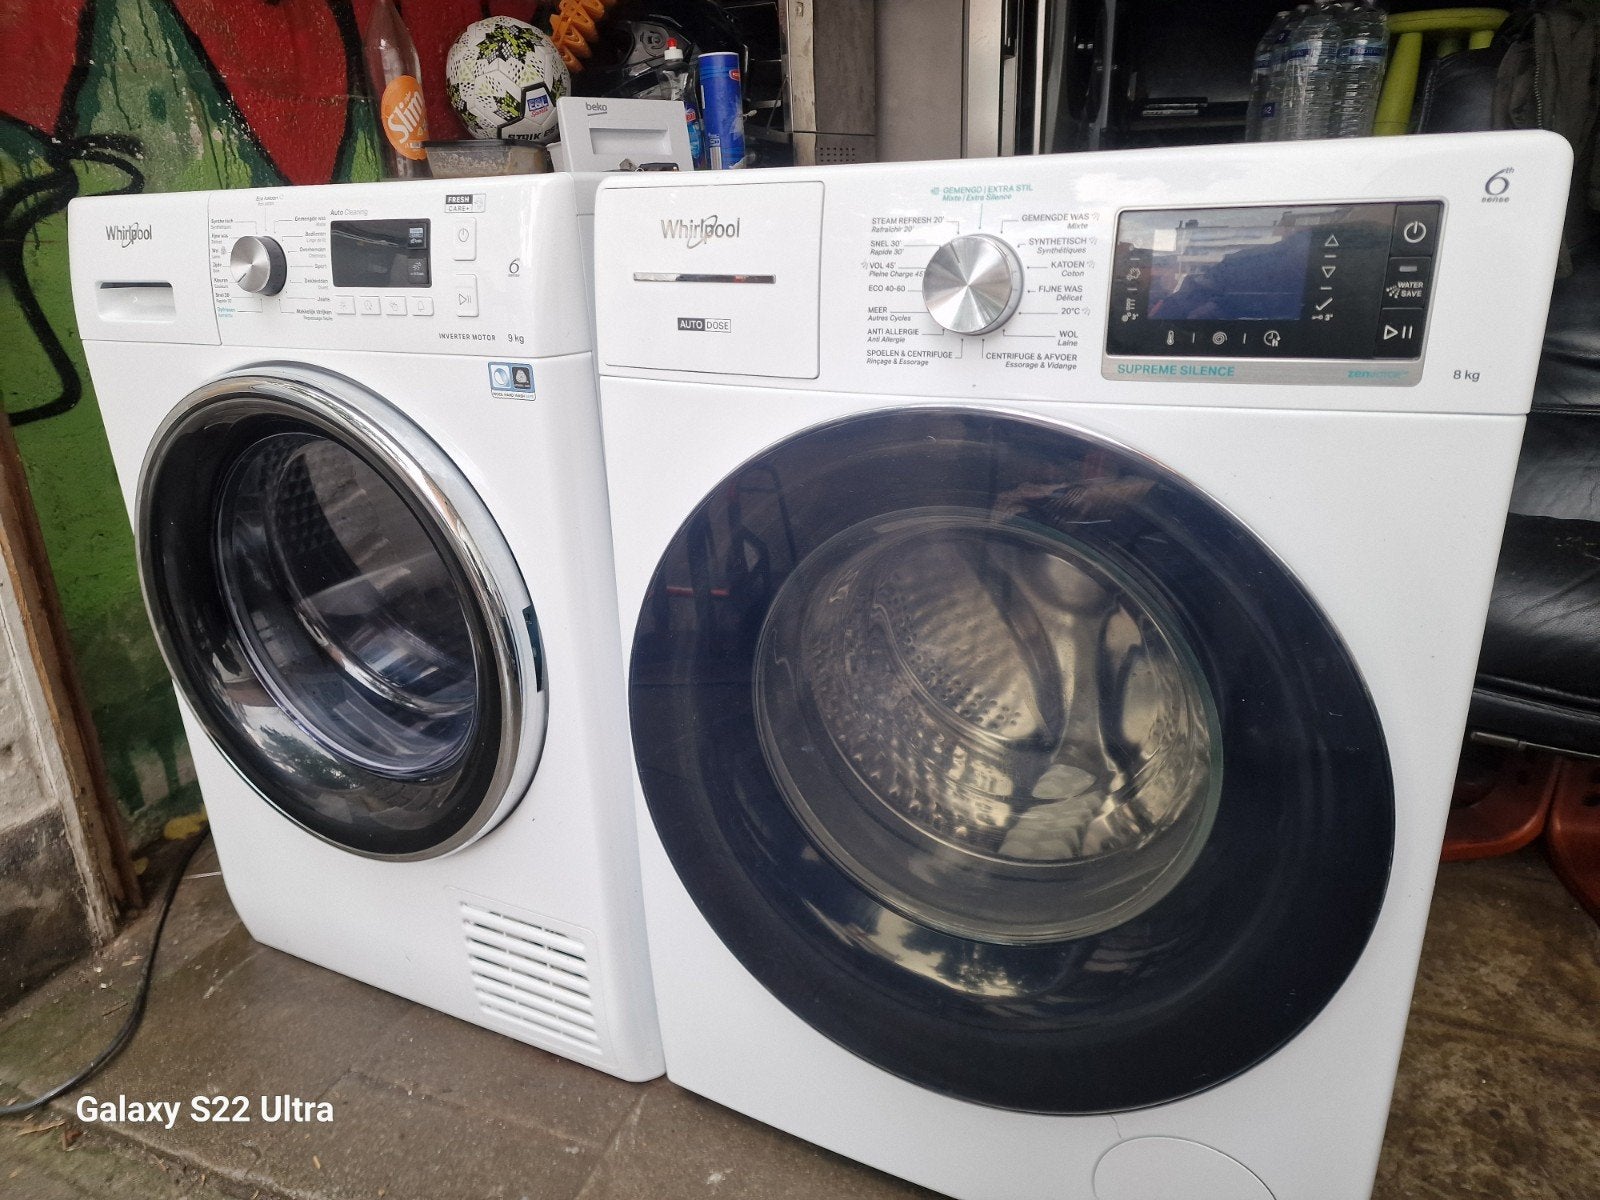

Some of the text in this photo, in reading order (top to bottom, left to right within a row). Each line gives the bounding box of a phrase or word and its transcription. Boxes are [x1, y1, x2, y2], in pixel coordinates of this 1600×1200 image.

[585, 102, 608, 112] beko
[388, 92, 425, 144] Slim
[988, 185, 1014, 193] EXTRA
[1016, 184, 1034, 192] STIL
[1021, 213, 1090, 222] GEMENGDE WAS
[105, 222, 152, 248] Whirlpool
[660, 214, 740, 249] Whirlpool
[1028, 238, 1087, 246] SYNTHETISCH
[870, 248, 893, 256] Rapide
[869, 262, 885, 270] VOL
[869, 270, 889, 278] Pleine
[890, 270, 914, 278] Charge
[1038, 285, 1083, 293] FIJNE WAS
[1401, 290, 1422, 298] SAVE
[889, 315, 911, 323] Cycles
[680, 320, 729, 330] AUTO DOSE
[885, 328, 919, 336] ALLERGIE
[1059, 330, 1078, 338] WOL
[508, 334, 513, 342] 9
[514, 334, 524, 344] kg
[881, 336, 906, 344] Allergie
[1058, 339, 1078, 347] Laine
[907, 351, 953, 359] CENTRIFUGE
[1044, 354, 1078, 362] AFVOER
[866, 358, 892, 366] Rinçage
[1005, 361, 1039, 369] Essorage
[1047, 362, 1077, 370] Vidange
[1117, 364, 1235, 377] SUPREME SILENCE
[1453, 370, 1480, 382] 8 kg
